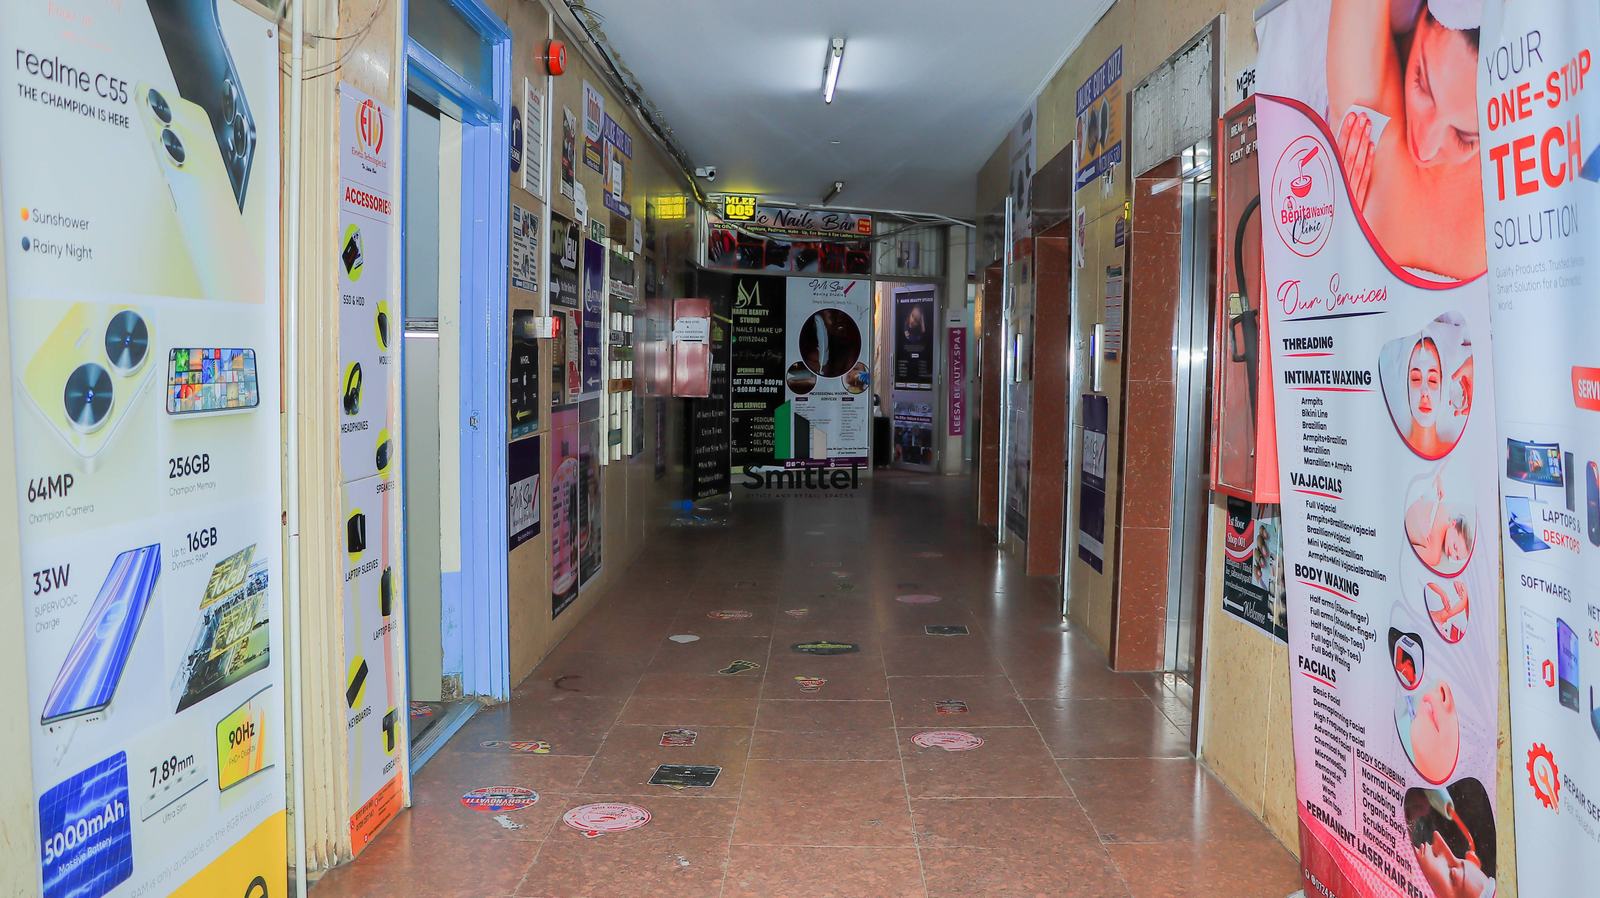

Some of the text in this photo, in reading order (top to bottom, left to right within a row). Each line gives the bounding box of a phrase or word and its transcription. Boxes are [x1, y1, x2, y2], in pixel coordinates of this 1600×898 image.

[1107, 50, 1121, 83] CUTZ
[1486, 30, 1543, 86] YOUR
[16, 48, 128, 104] realme C55
[1487, 49, 1591, 131] ONE-STOP
[18, 83, 130, 129] THE CHAMPION IS HERE
[1230, 122, 1243, 138] BREAK
[1241, 133, 1246, 144] IN
[1230, 143, 1251, 164] EVENT OF
[1489, 112, 1583, 201] TECH
[345, 187, 392, 216] ACCESSORIES
[725, 196, 756, 205] MLEE
[726, 204, 754, 216] 005
[32, 209, 90, 230] Sunshower
[774, 209, 815, 230] Nails
[821, 212, 855, 231] Bar
[1281, 204, 1311, 225] Benita
[1494, 202, 1578, 250] SOLUTION
[1292, 218, 1321, 244] Clinic
[33, 238, 92, 261] Rainy Night
[1277, 272, 1387, 315] Our Services
[1283, 336, 1333, 350] THREADING
[1284, 370, 1372, 385] INTIMATE WAXING
[1301, 397, 1323, 408] Armpits
[1302, 409, 1328, 419] Bikini Line
[341, 420, 368, 434] HEADPHONES
[953, 401, 961, 433] LEESA
[169, 453, 210, 479] 256GB
[1334, 462, 1352, 474] Armpits
[27, 473, 74, 503] 64MP
[169, 481, 217, 497] Champion Memory
[1290, 472, 1342, 494] VAJACIALS
[29, 503, 94, 525] Champion Camera
[1306, 500, 1337, 514] Full Vajacial
[1541, 508, 1581, 533] LAPTOPS &
[171, 548, 180, 559] Up
[187, 527, 217, 552] 16GB
[1307, 538, 1319, 547] Mini
[1543, 529, 1580, 554] DESKTOPS
[171, 556, 195, 572] Dynamic
[345, 566, 361, 582] LAPTOP
[33, 563, 70, 596] 33W
[1295, 564, 1360, 597] BODY WAXING
[1521, 574, 1572, 603] SOFTWARES
[34, 594, 79, 618] SUPERVOOC
[1310, 594, 1334, 608] Half arms
[35, 618, 60, 635] Charge
[1310, 607, 1321, 617] Full
[1321, 611, 1334, 622] arms
[1311, 620, 1333, 635] Half legs
[1311, 632, 1322, 642] Full
[1321, 634, 1332, 648] legs
[1298, 655, 1336, 683] FACIALS
[1311, 644, 1351, 672] Full Body Waxing
[1313, 685, 1341, 706] Basic Facial
[348, 706, 372, 730] KEYBOARDS
[1313, 711, 1327, 723] High
[1349, 732, 1365, 748] Facial
[1349, 719, 1365, 735] Facial
[228, 721, 255, 750] 90Hz
[1314, 724, 1352, 753] Advanced Facial
[1314, 736, 1338, 757] Chemical
[149, 753, 194, 788] 7.89mm
[1356, 748, 1406, 787] BODY SCRUBBING
[1321, 774, 1336, 788] Moles
[1362, 767, 1404, 807] Normal body
[1563, 774, 1586, 807] REPAIR
[1322, 795, 1332, 808] Skin
[1362, 782, 1396, 817] Scrubbing
[162, 802, 188, 824] Ultra Slim
[1363, 797, 1406, 840] Organic body
[45, 799, 125, 865] 5000mAh
[1363, 812, 1396, 849] Scrubbing
[58, 836, 113, 877] Massive Battery
[1306, 800, 1406, 891] PERMANENT LASER HAIR
[1363, 826, 1412, 874] Moroccan bath
